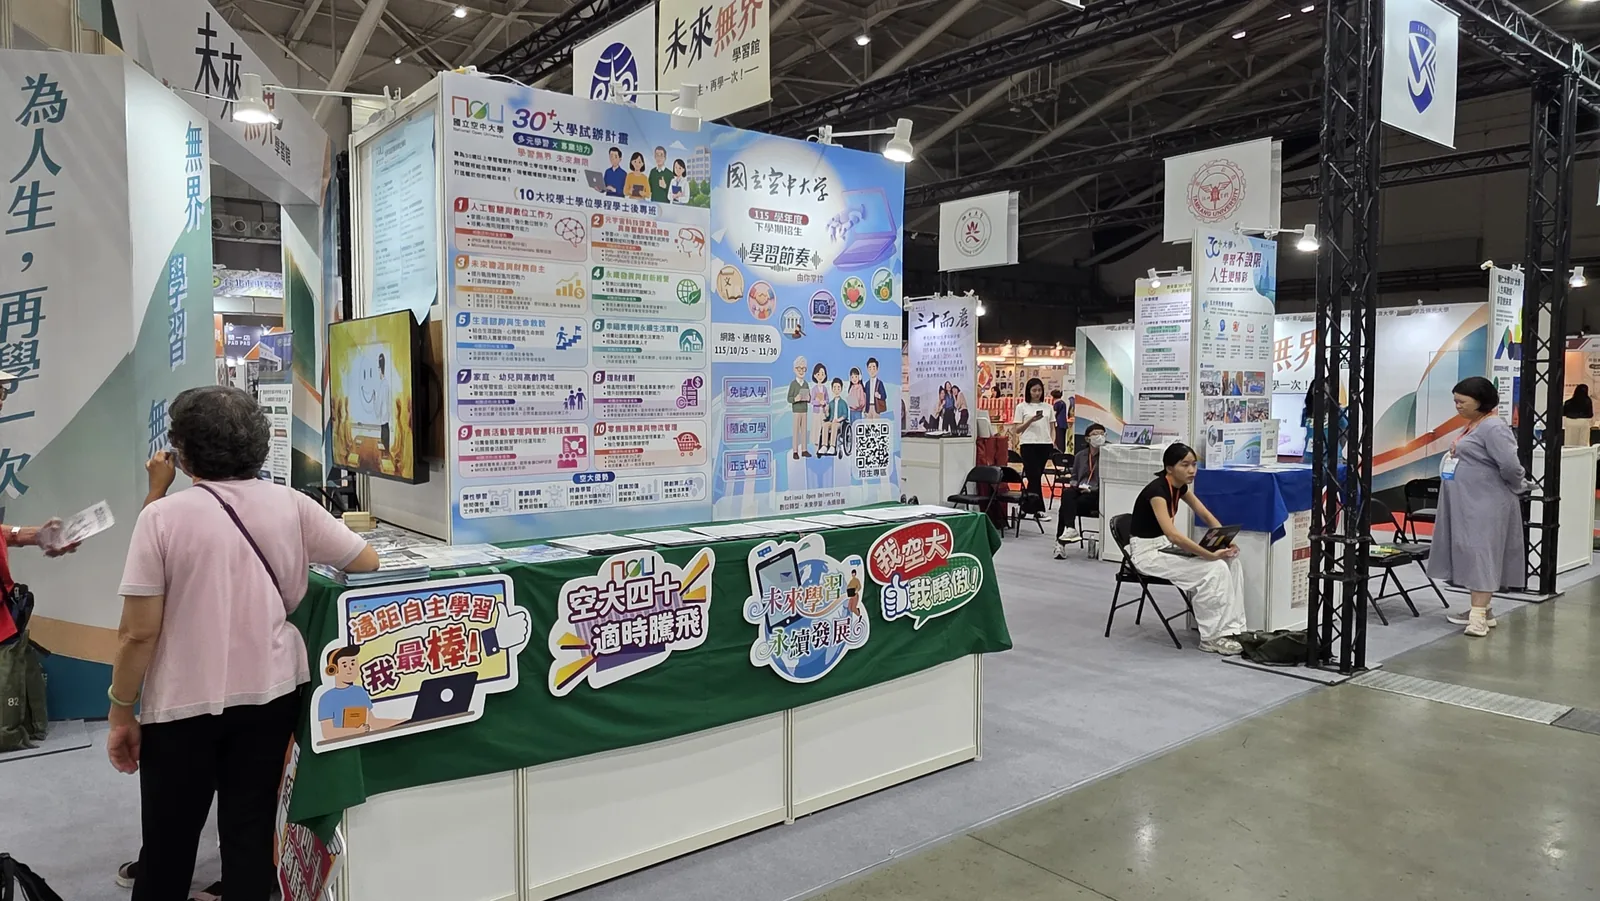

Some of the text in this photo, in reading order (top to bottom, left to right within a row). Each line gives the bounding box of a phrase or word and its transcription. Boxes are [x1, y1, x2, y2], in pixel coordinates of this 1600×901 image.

[663, 0, 763, 75] 未來無界
[732, 38, 760, 62] 學習館
[453, 117, 504, 134] 國立空中大學
[517, 134, 549, 149] 多元學習
[561, 140, 591, 154] 專業培力
[518, 148, 589, 167] 學習無界 未來無限
[1193, 187, 1239, 217] TAMKANG UNIVERSITY
[471, 202, 553, 220] 人工智慧與數位工作力
[754, 210, 803, 225] 115 學年度
[754, 221, 803, 237] 下學期招生
[749, 242, 811, 267] 學習節奏
[1222, 252, 1262, 268] 學習不設限
[471, 259, 546, 274] 未來職涯與財務自主
[1210, 266, 1248, 283] 人生更精彩
[796, 274, 824, 284] 由你掌控
[168, 253, 188, 372] 學習
[854, 319, 889, 330] 現場報名
[720, 332, 772, 344] 網路、通信報名
[844, 331, 874, 341] 115/12/12
[883, 332, 899, 341] 12/13
[714, 345, 749, 356] 115/10/25
[759, 347, 778, 356] 11/30
[473, 373, 555, 382] 家庭、幼兒與高齡跨域
[607, 374, 636, 382] 理財規劃
[730, 386, 767, 399] 免試入學
[474, 426, 579, 438] 會展活動管理與智慧科技運用
[608, 423, 678, 433] 零售服務業與物流管理
[730, 422, 767, 435] 隨處可學
[730, 459, 767, 472] 正式學位
[579, 473, 609, 483] 空大優勢
[859, 469, 888, 479] 招生專區
[463, 493, 488, 501] 彈性學習
[874, 528, 947, 576] 我空大
[764, 574, 843, 616] 未來學習
[909, 567, 977, 610] 我驕傲！
[569, 574, 680, 622] 空大四十
[351, 594, 494, 643] 遠距自主學習
[594, 608, 701, 656] 適時騰飛
[770, 619, 851, 659] 永續發展
[363, 624, 480, 694] 我最棒！
[8, 698, 19, 706] 82
